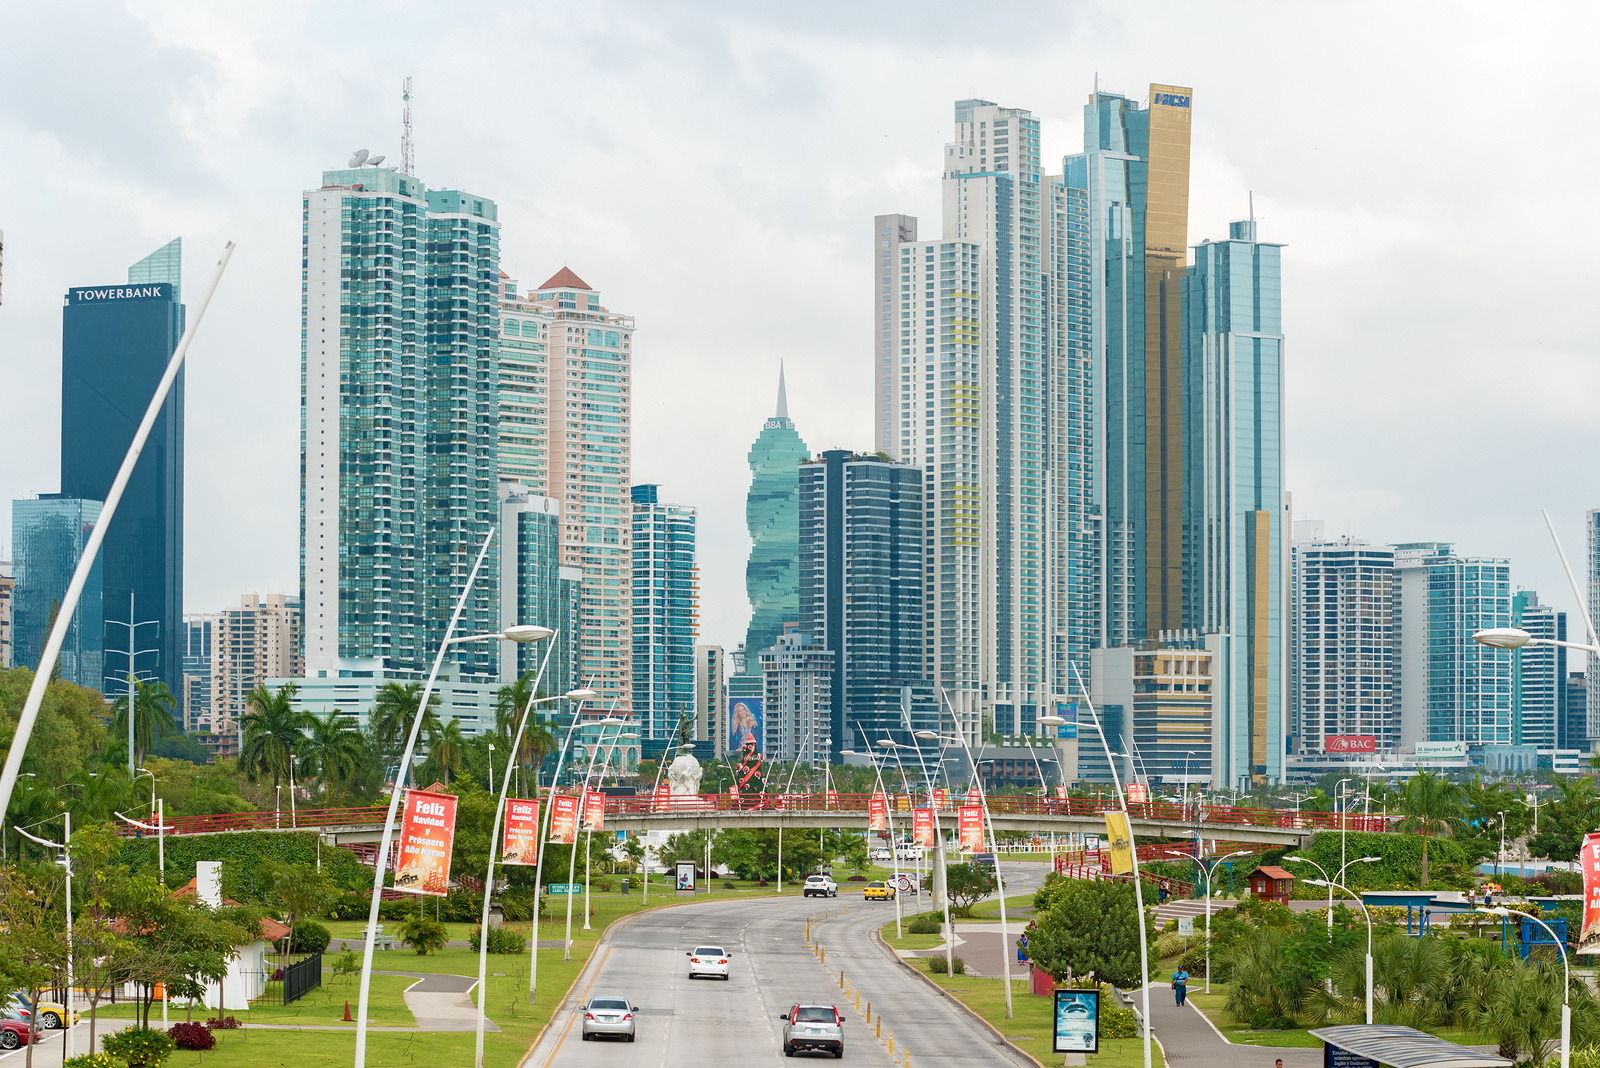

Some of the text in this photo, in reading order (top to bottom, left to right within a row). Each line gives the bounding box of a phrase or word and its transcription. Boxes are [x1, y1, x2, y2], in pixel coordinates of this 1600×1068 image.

[76, 287, 162, 301] TOWERBANK
[1350, 740, 1372, 749] BAC
[416, 801, 445, 816] Feliz
[512, 805, 532, 815] Feliz
[413, 815, 445, 827] Navidad
[408, 835, 445, 848] Próspero
[404, 845, 445, 858] Año Nuevo
